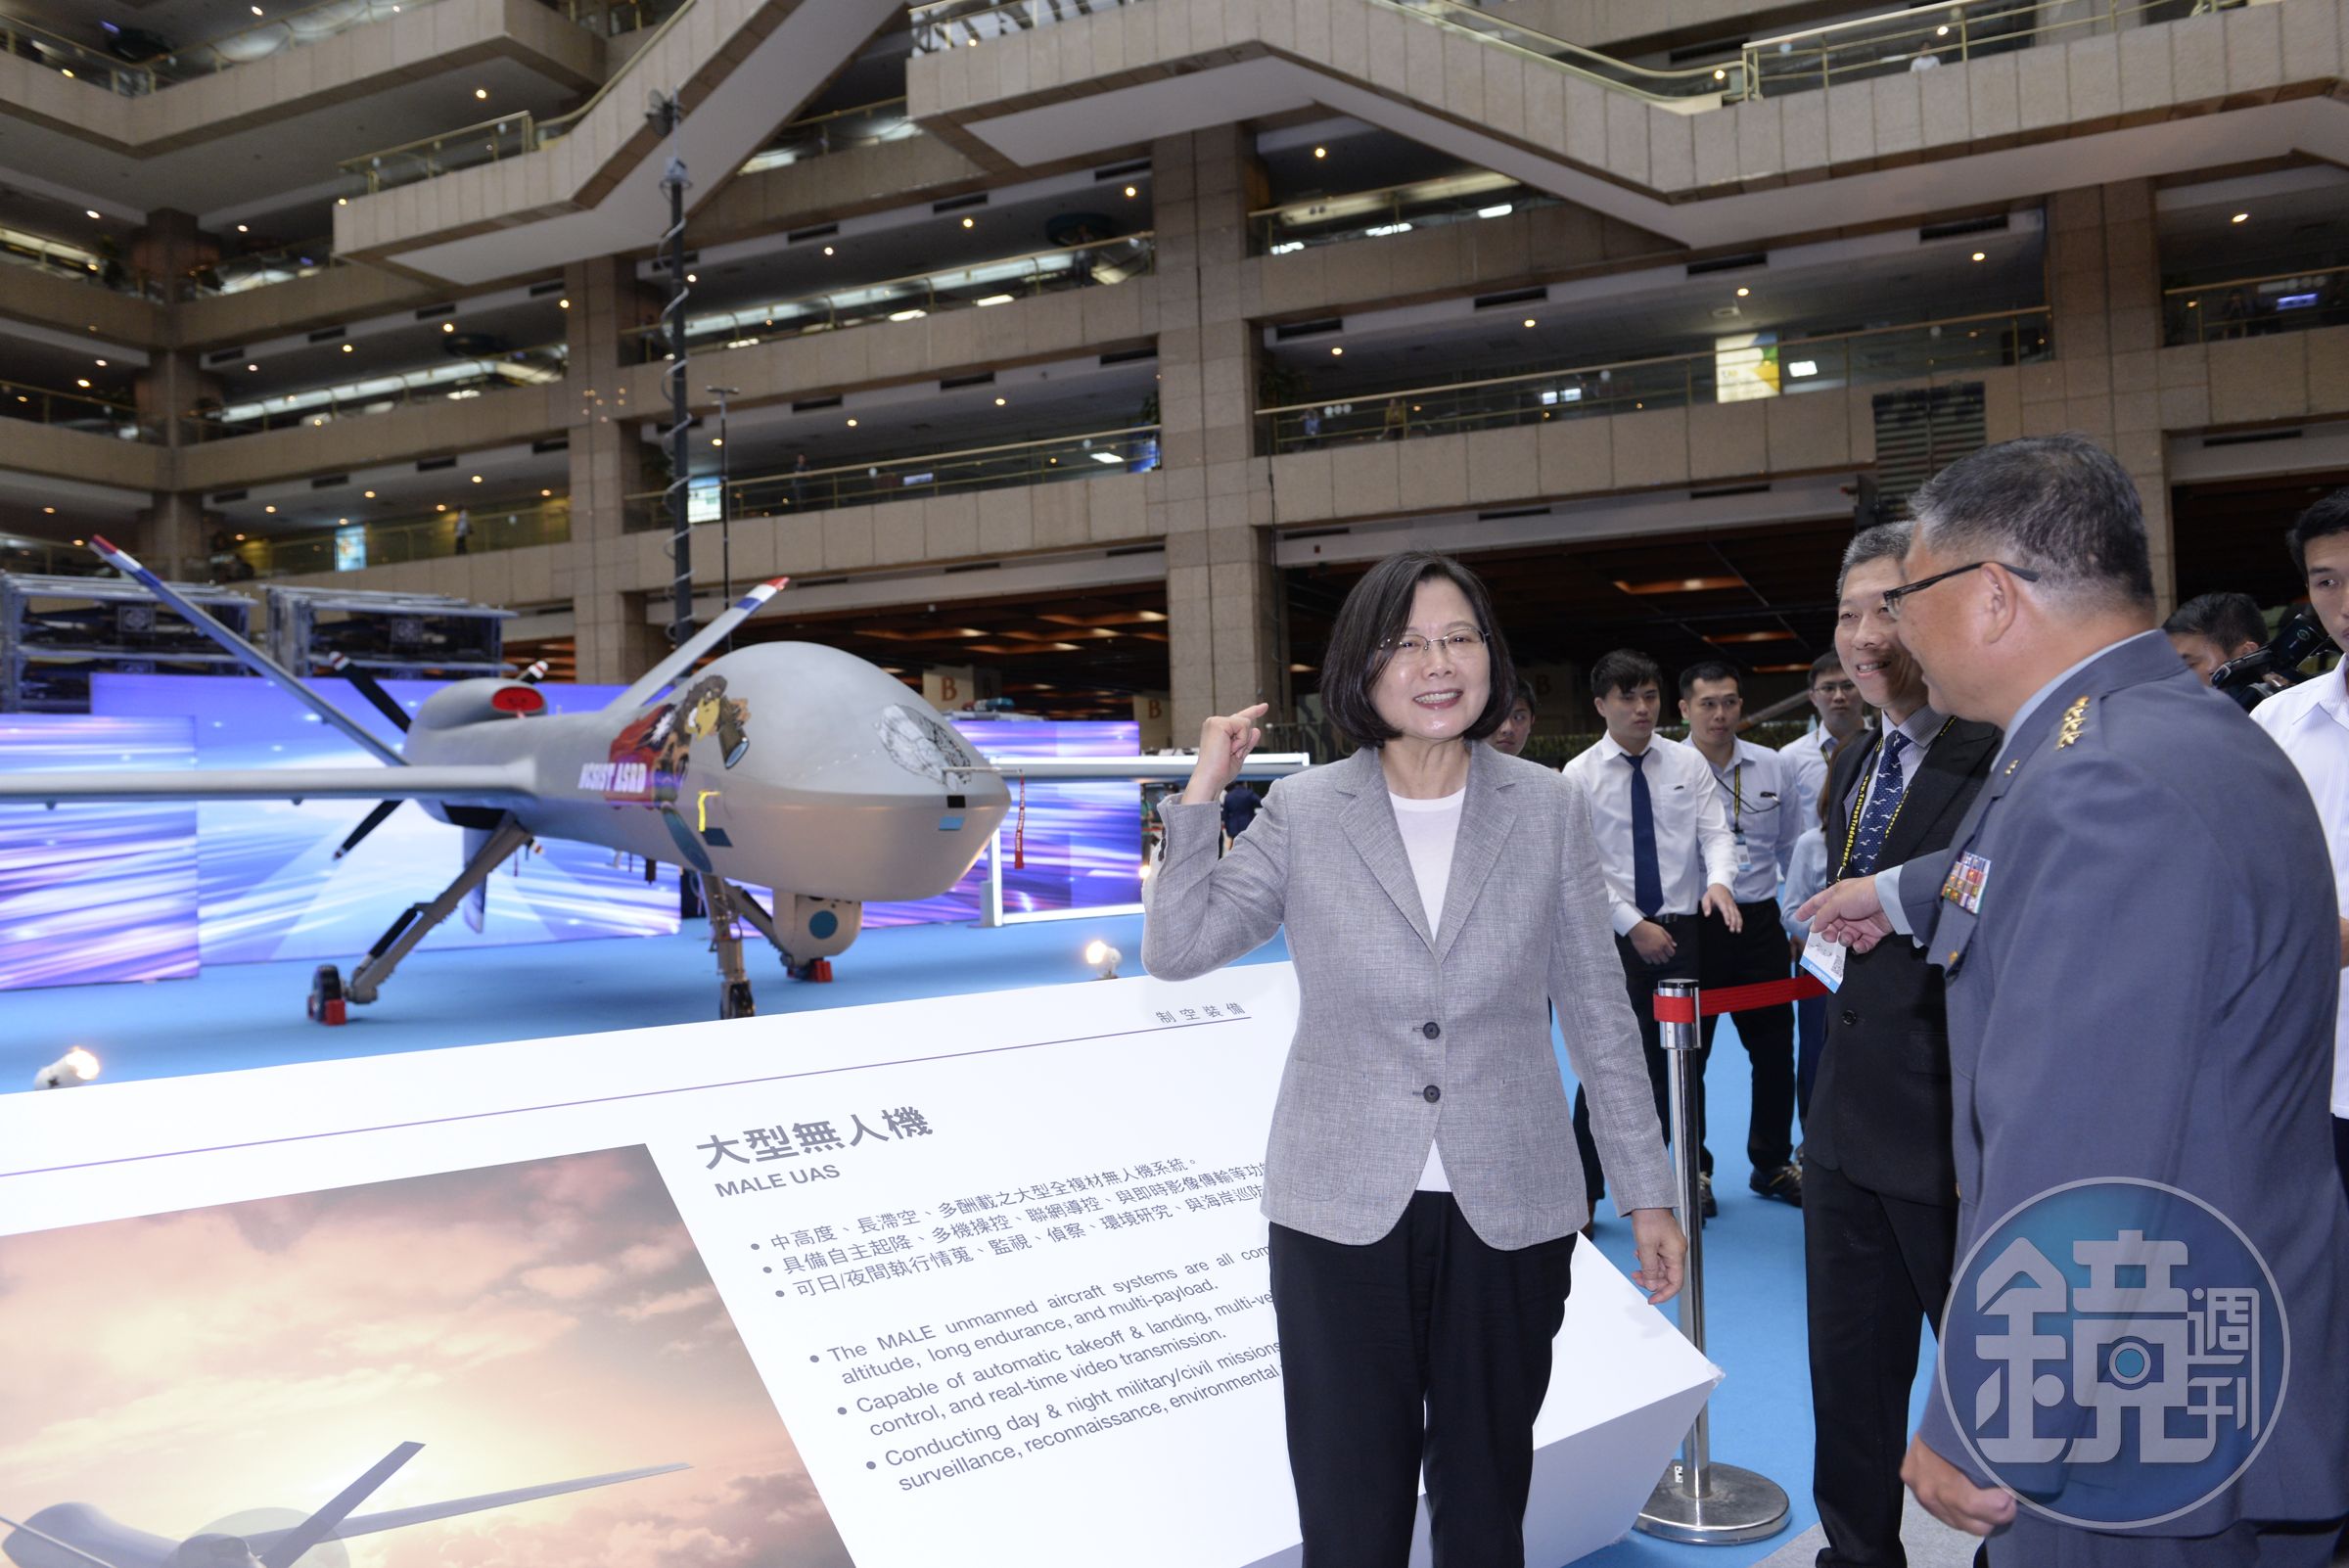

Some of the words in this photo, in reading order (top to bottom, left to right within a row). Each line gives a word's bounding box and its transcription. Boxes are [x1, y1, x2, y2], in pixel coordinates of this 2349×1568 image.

[941, 676, 957, 702] B
[1148, 699, 1163, 719] B
[1155, 1002, 1246, 1025] 制空裝備
[696, 1106, 933, 1170] 大型無人機
[714, 1174, 787, 1197] MALE
[789, 1165, 840, 1183] UAS
[783, 1162, 1265, 1274] 具備自主起降、多機操控、聯網導控、與即時影像傳輸等功
[827, 1346, 867, 1361] The
[877, 1325, 937, 1351] MALE
[945, 1300, 1038, 1333] unmanned
[1047, 1285, 1106, 1309] aircraft
[1113, 1269, 1177, 1293] systems
[1184, 1262, 1210, 1274] are
[1217, 1253, 1234, 1267] all
[842, 1357, 921, 1384] altitude,
[927, 1343, 972, 1361] long
[974, 1319, 1073, 1350] endurance,
[1074, 1306, 1106, 1324] and
[1108, 1278, 1219, 1315] multi-payload.
[856, 1382, 939, 1412] Capable
[946, 1372, 965, 1388] of
[973, 1350, 1061, 1382] automatic
[1066, 1330, 1125, 1356] takeoff
[1129, 1326, 1145, 1339] &
[1146, 1312, 1212, 1334] landing,
[1215, 1289, 1272, 1316] multi-ve
[870, 1405, 945, 1436] control,
[948, 1392, 986, 1413] and
[989, 1372, 1068, 1403] real-time
[1070, 1359, 1118, 1378] video
[1119, 1330, 1226, 1365] transmission.
[886, 1425, 1001, 1466] Conducting
[1006, 1412, 1039, 1431] day
[1046, 1404, 1063, 1418] &
[1066, 1390, 1113, 1413] night
[1116, 1360, 1214, 1399] military/civil
[1217, 1341, 1281, 1369] missions
[898, 1447, 1023, 1491] surveillance,
[1024, 1403, 1169, 1453] reconnaissance,
[1170, 1363, 1280, 1407] environmental
